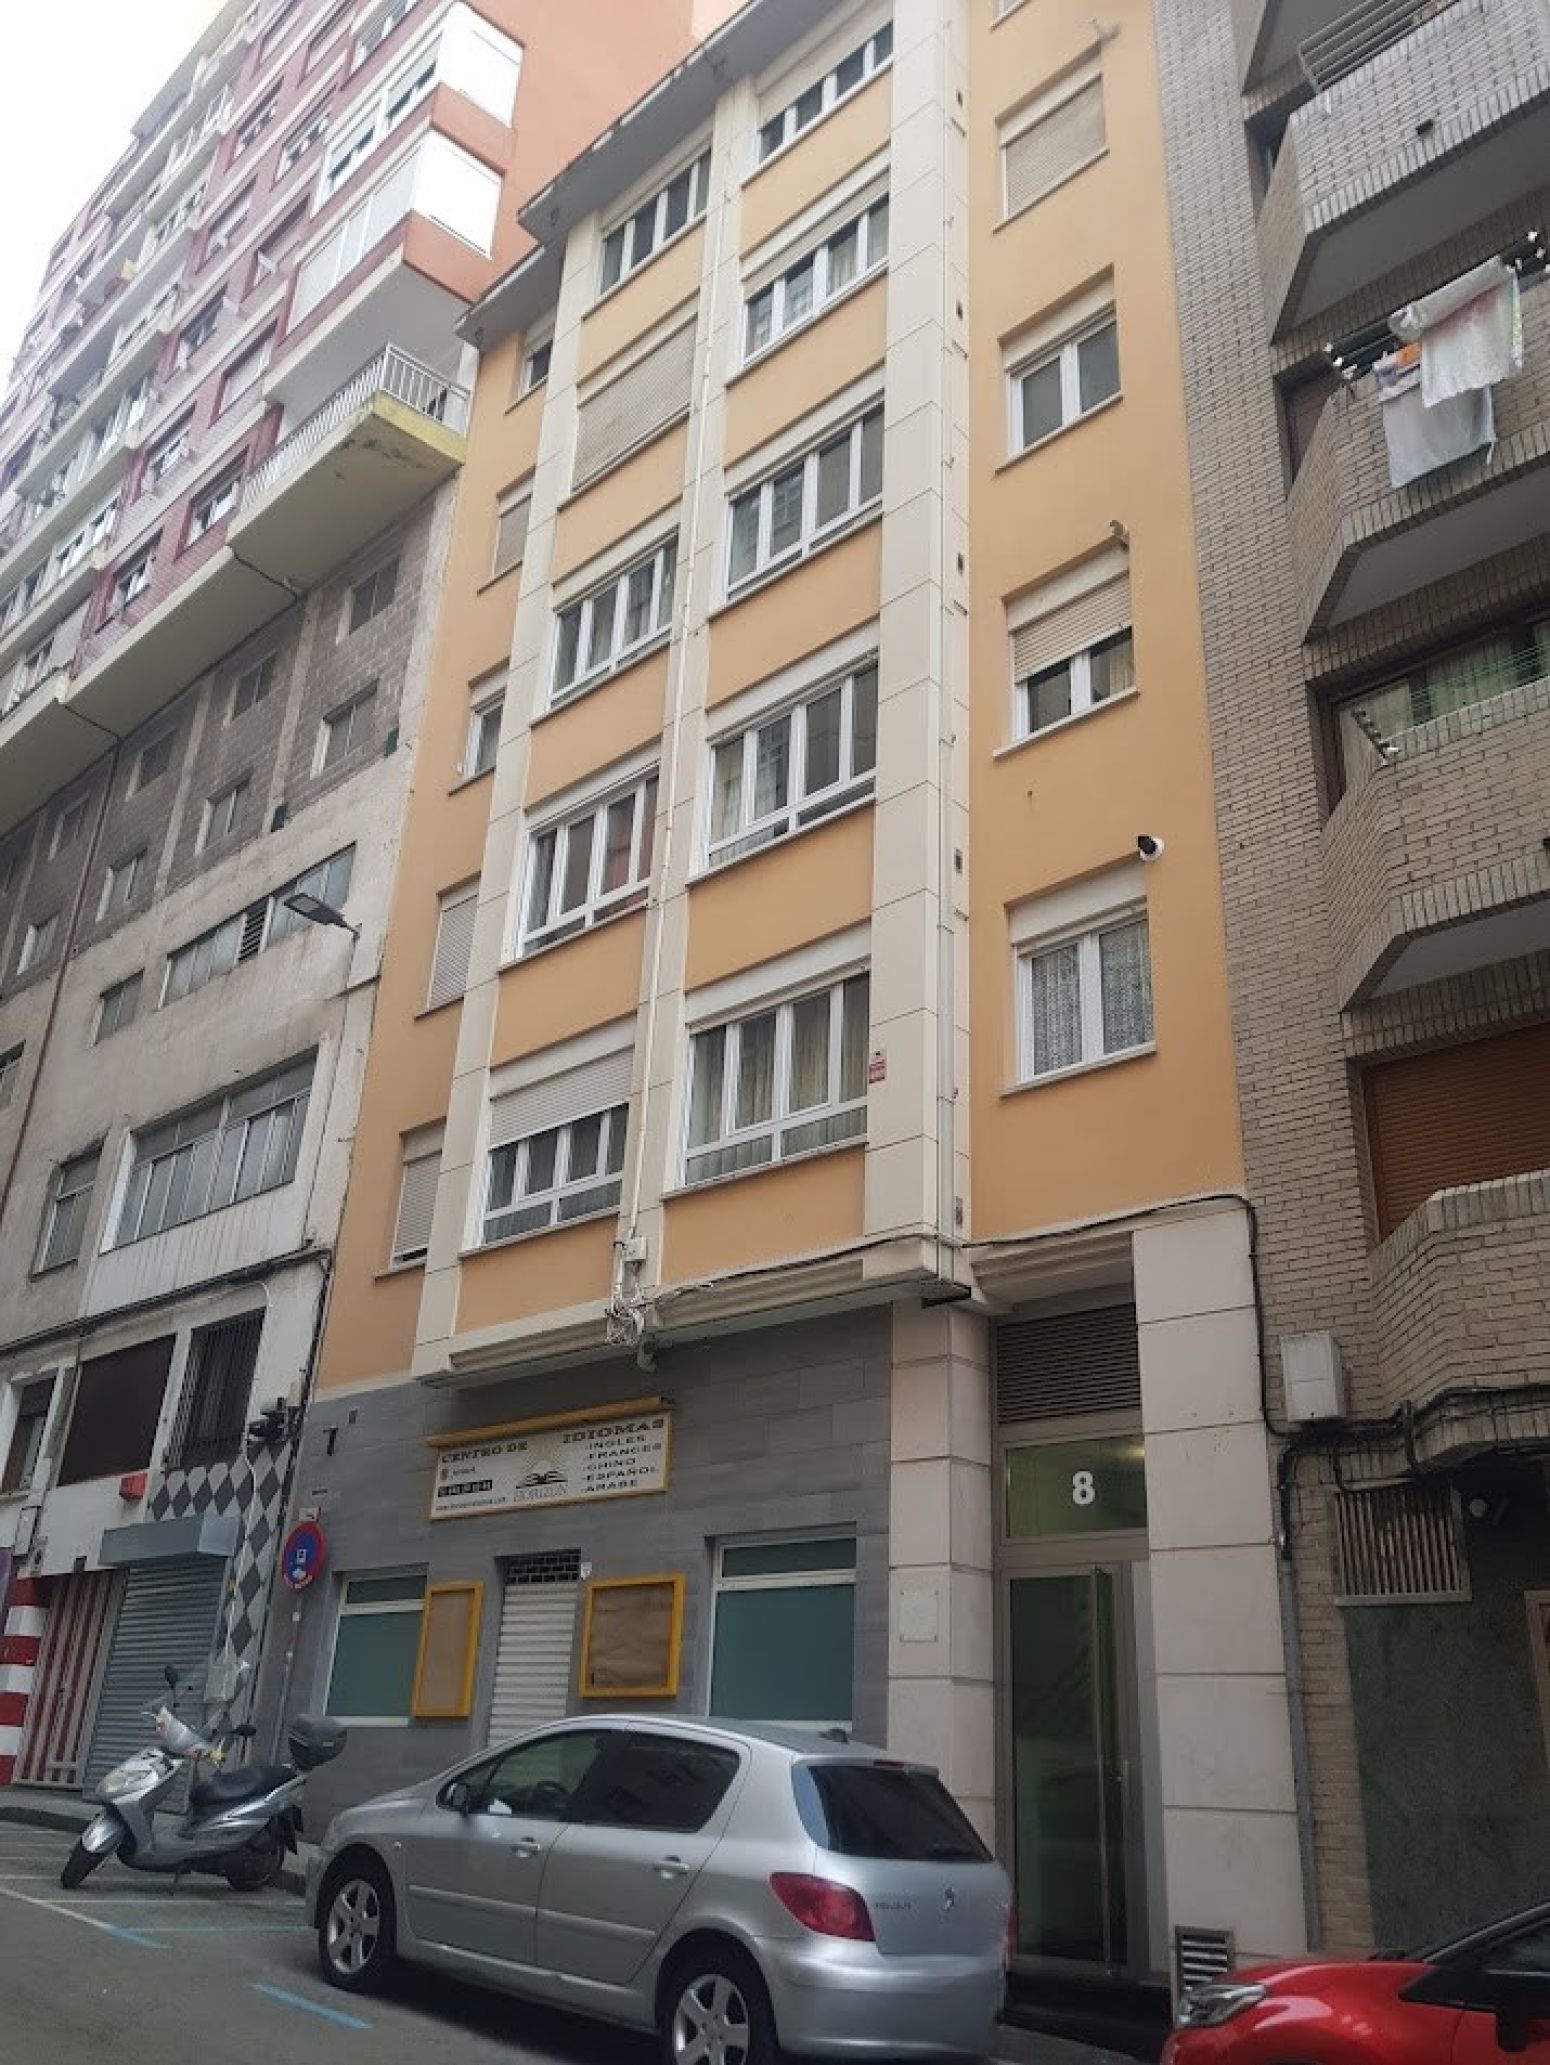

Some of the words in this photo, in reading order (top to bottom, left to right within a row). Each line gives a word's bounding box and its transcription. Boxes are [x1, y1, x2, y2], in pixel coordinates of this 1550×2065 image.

[441, 1445, 502, 1463] CENTRO
[507, 1441, 528, 1453] DE
[562, 1418, 664, 1444] IDIOMAS
[1073, 1470, 1096, 1505] 8
